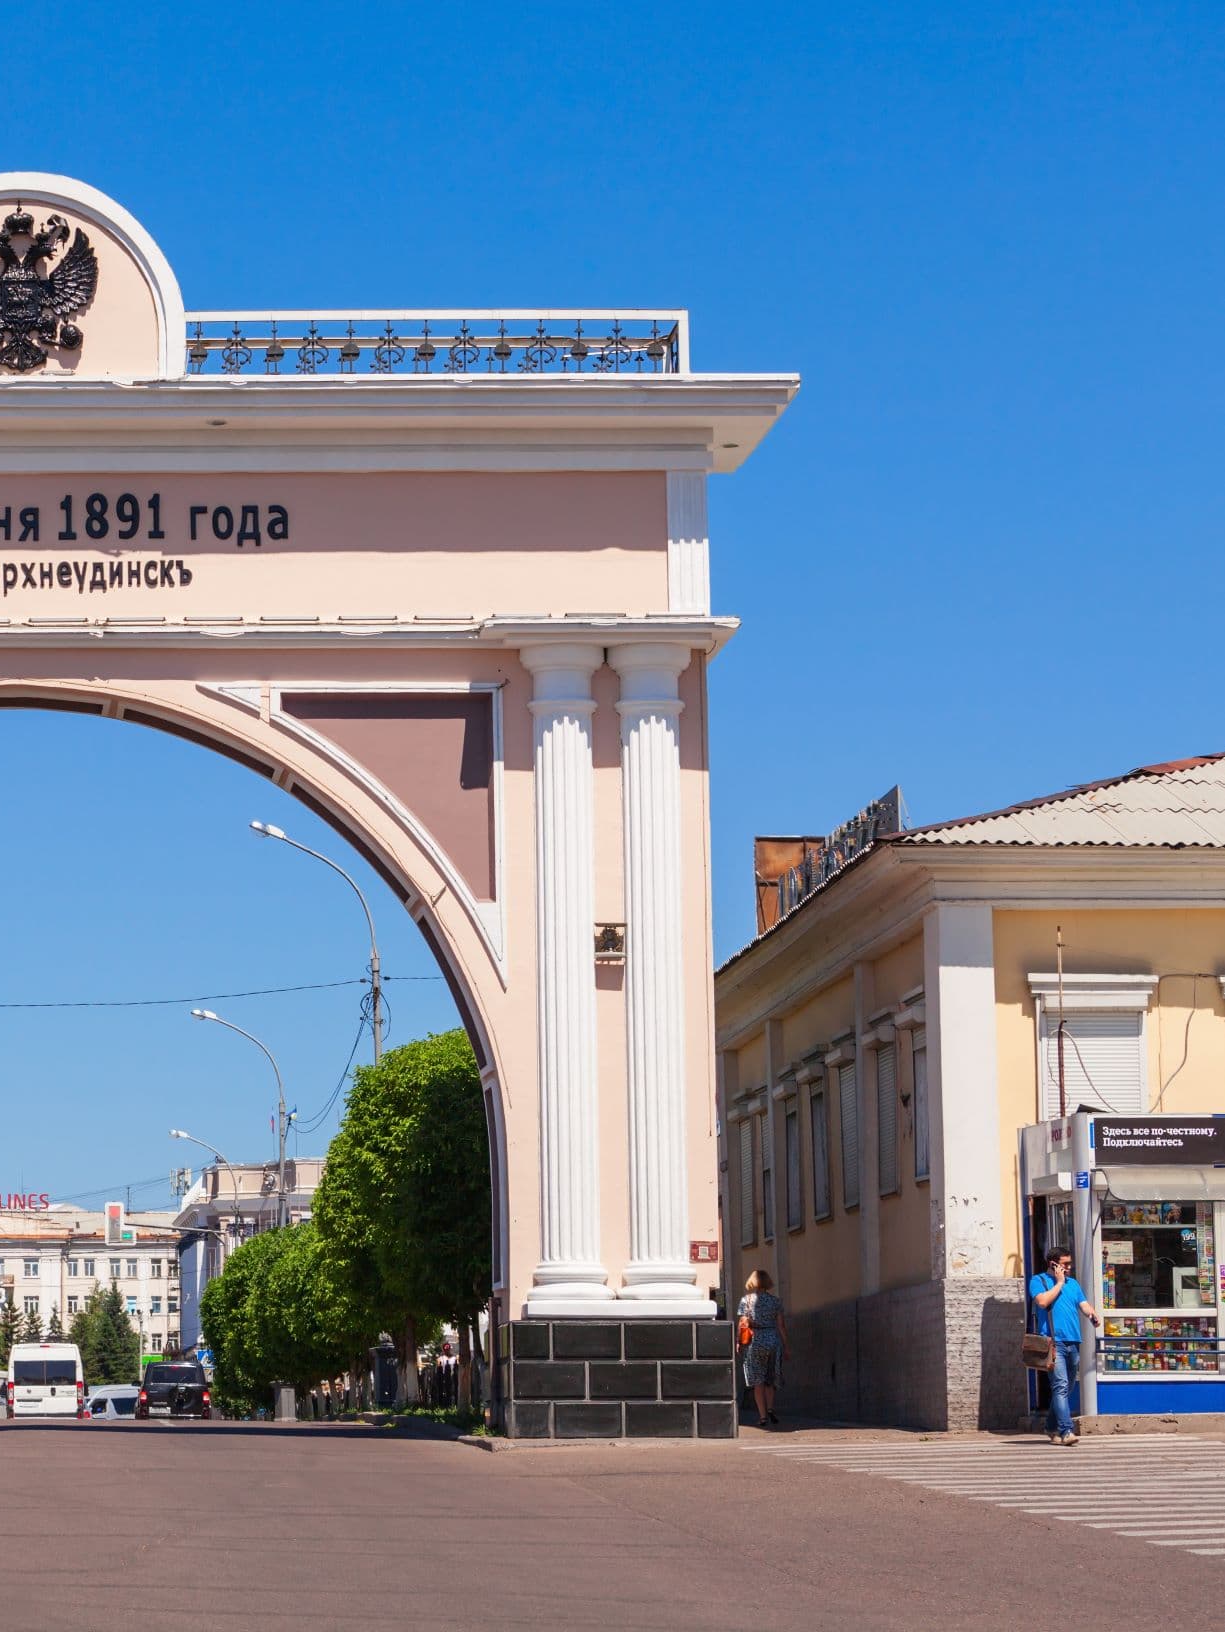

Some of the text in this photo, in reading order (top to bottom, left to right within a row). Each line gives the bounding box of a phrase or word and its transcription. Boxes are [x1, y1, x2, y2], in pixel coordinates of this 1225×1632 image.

[58, 492, 165, 541] 1891
[189, 504, 289, 548] года
[1102, 1126, 1217, 1138] Здесь все по-честному.
[1102, 1137, 1184, 1148] Подключайтесь
